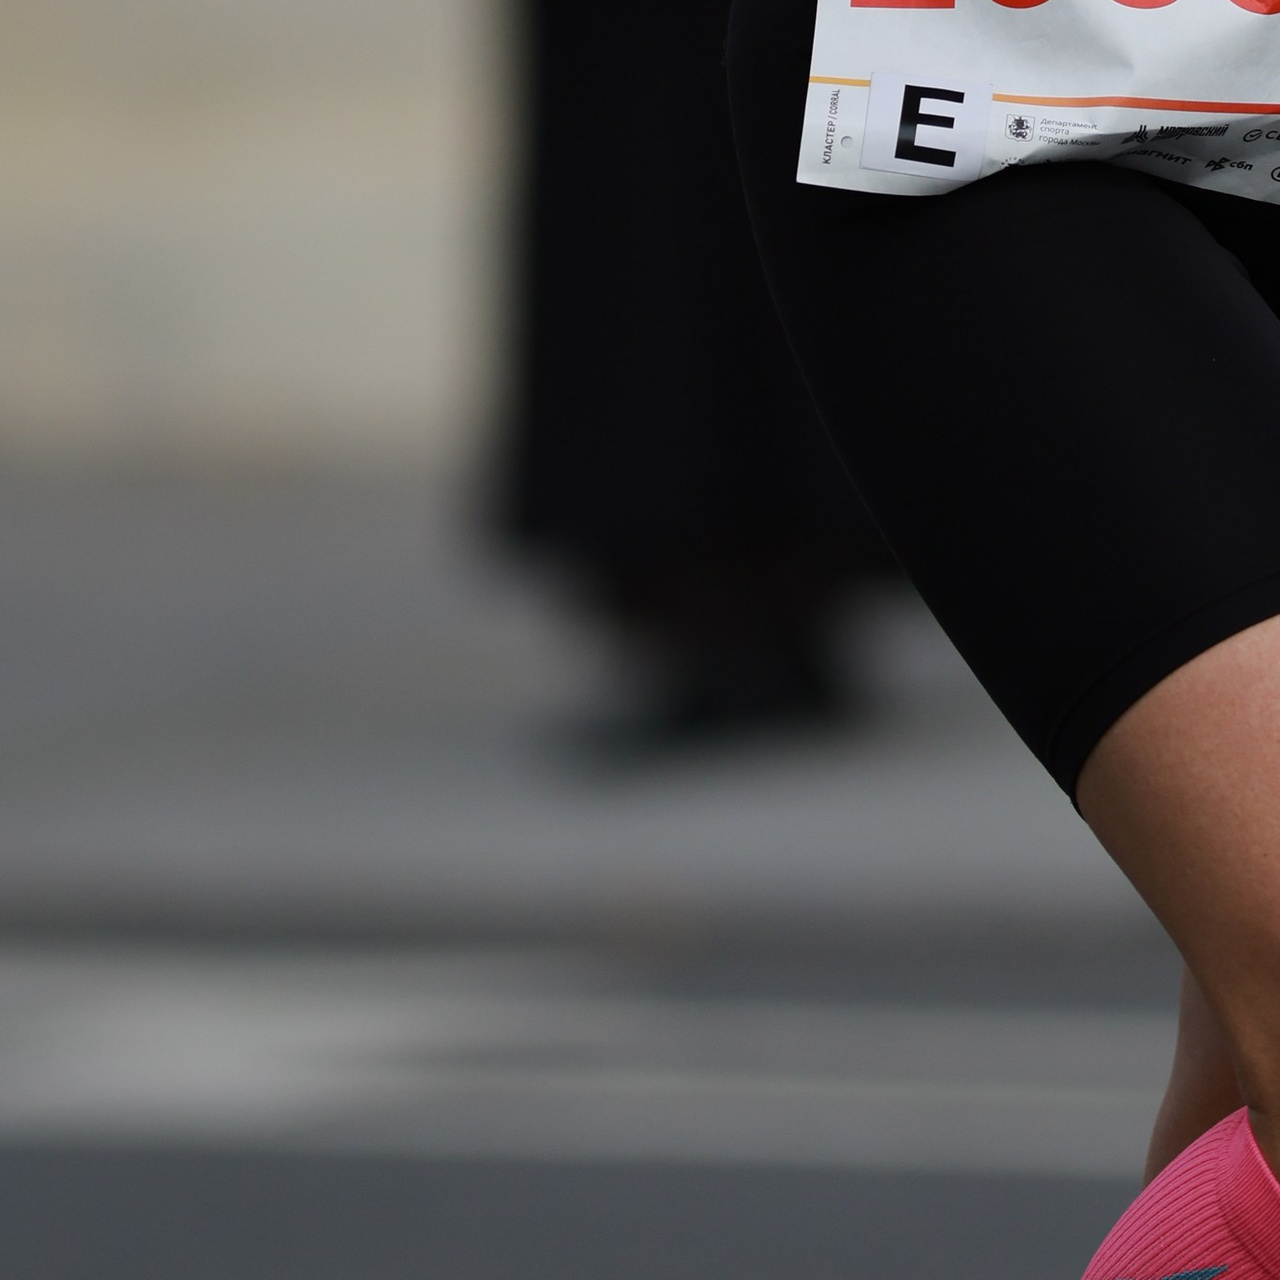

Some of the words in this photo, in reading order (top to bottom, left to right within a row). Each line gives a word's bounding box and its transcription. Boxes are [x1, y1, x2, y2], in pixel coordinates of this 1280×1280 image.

[822, 120, 836, 165] КЛАСТЕР
[829, 89, 841, 115] CORRAL
[894, 84, 965, 167] E
[1040, 126, 1070, 136] спорта
[1038, 134, 1068, 146] города
[1229, 160, 1253, 171] сбп
